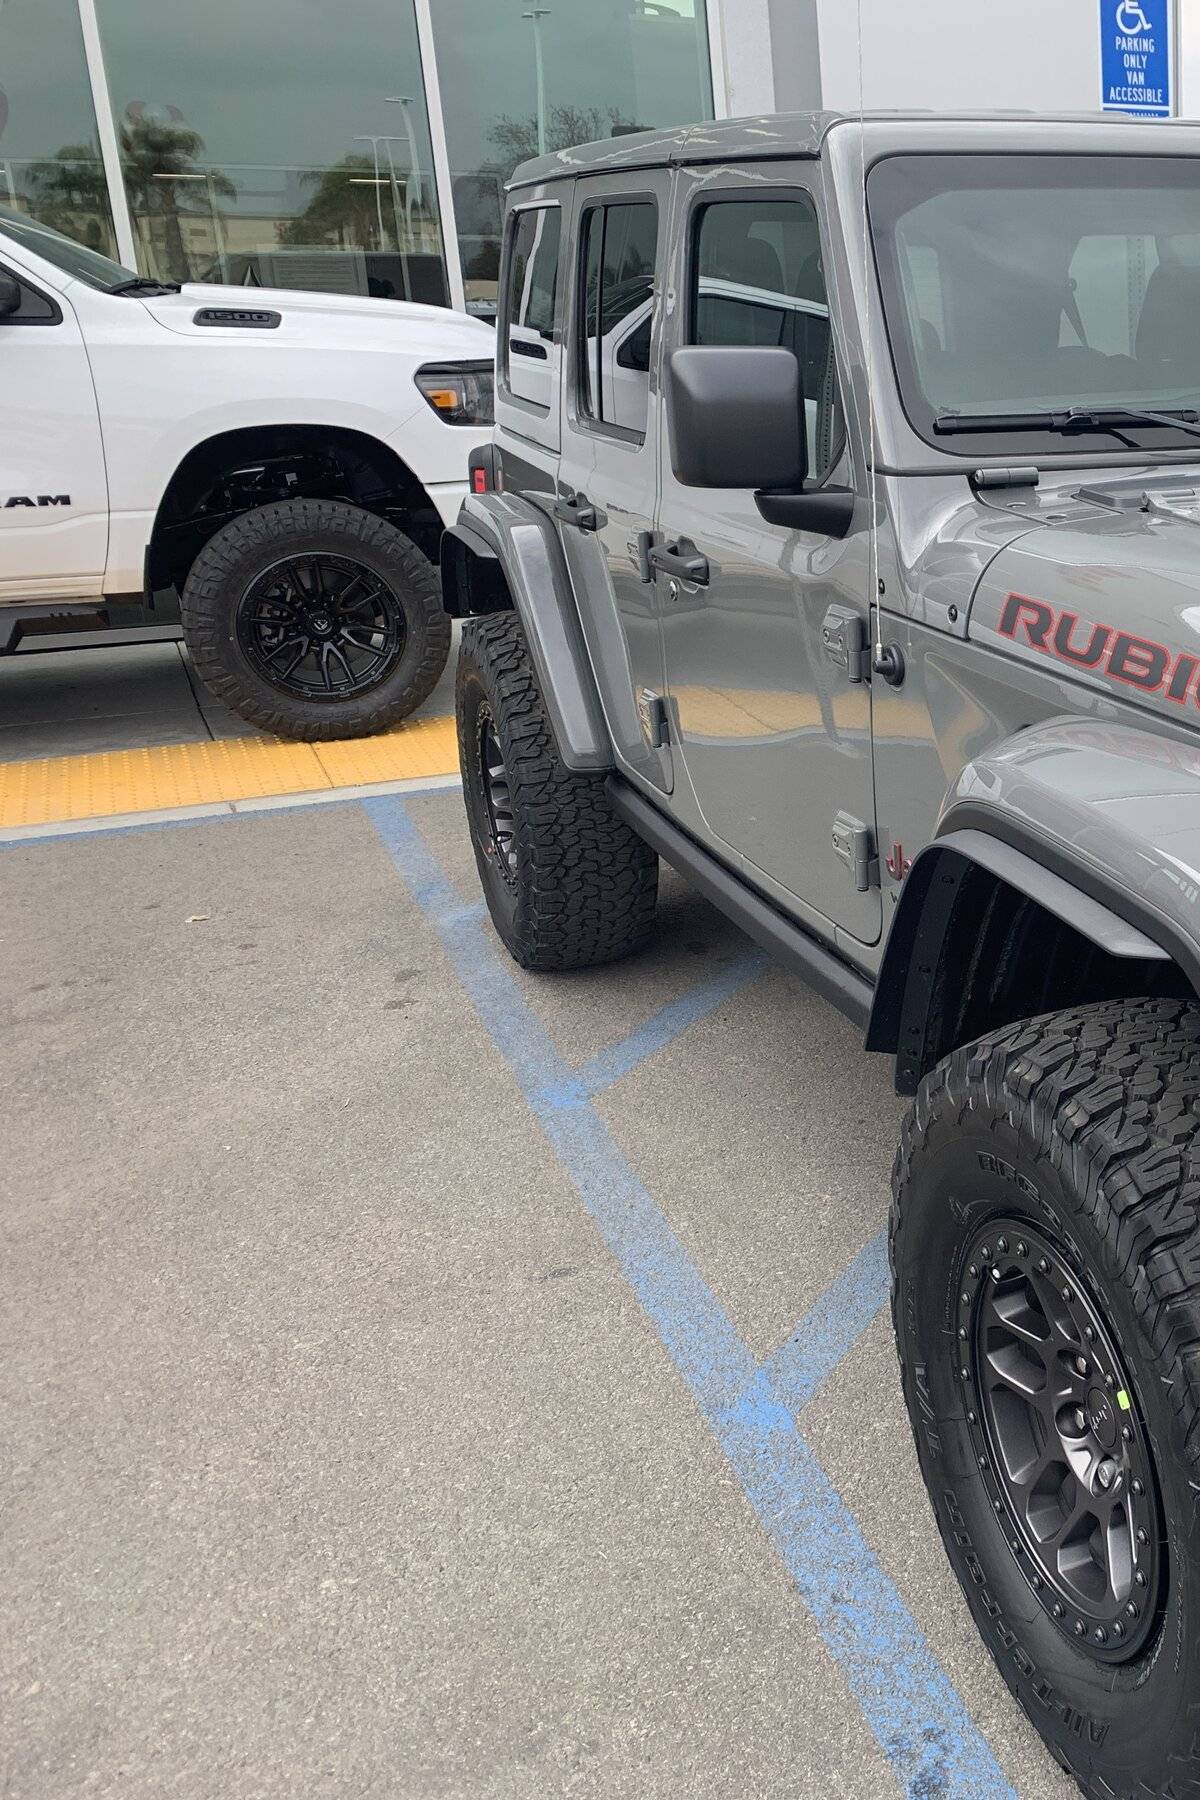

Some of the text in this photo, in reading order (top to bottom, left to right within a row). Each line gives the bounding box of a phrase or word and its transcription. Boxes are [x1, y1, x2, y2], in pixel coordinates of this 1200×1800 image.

[1115, 36, 1155, 53] PARKING
[1123, 54, 1148, 69] ONLY
[1126, 70, 1145, 85] VAN
[1109, 87, 1163, 103] ACCESSIBLE
[202, 310, 270, 322] 1500
[0, 494, 71, 509] AM
